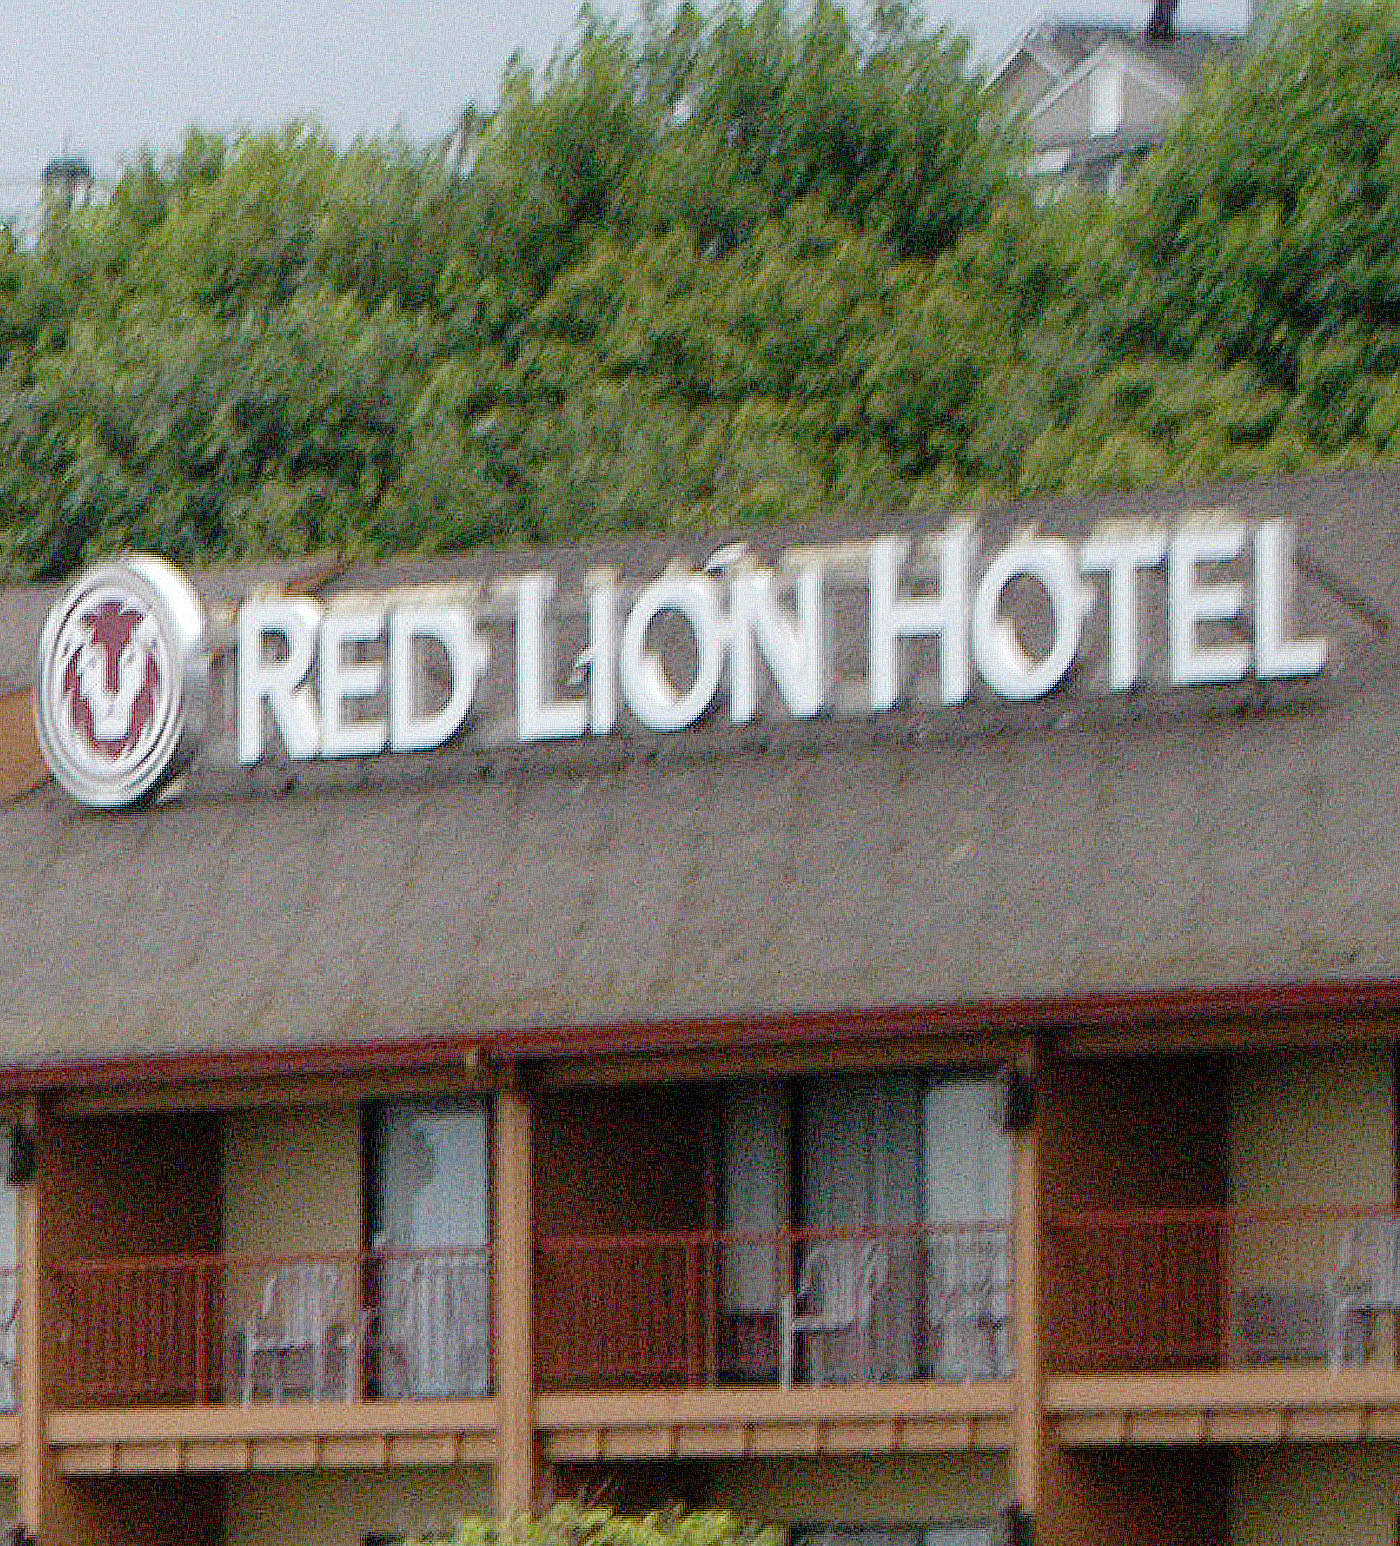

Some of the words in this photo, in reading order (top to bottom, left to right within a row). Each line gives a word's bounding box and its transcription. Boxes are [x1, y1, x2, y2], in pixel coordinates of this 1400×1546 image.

[237, 592, 482, 766] RED
[515, 570, 827, 742] LION
[868, 514, 1330, 713] HOTEL
